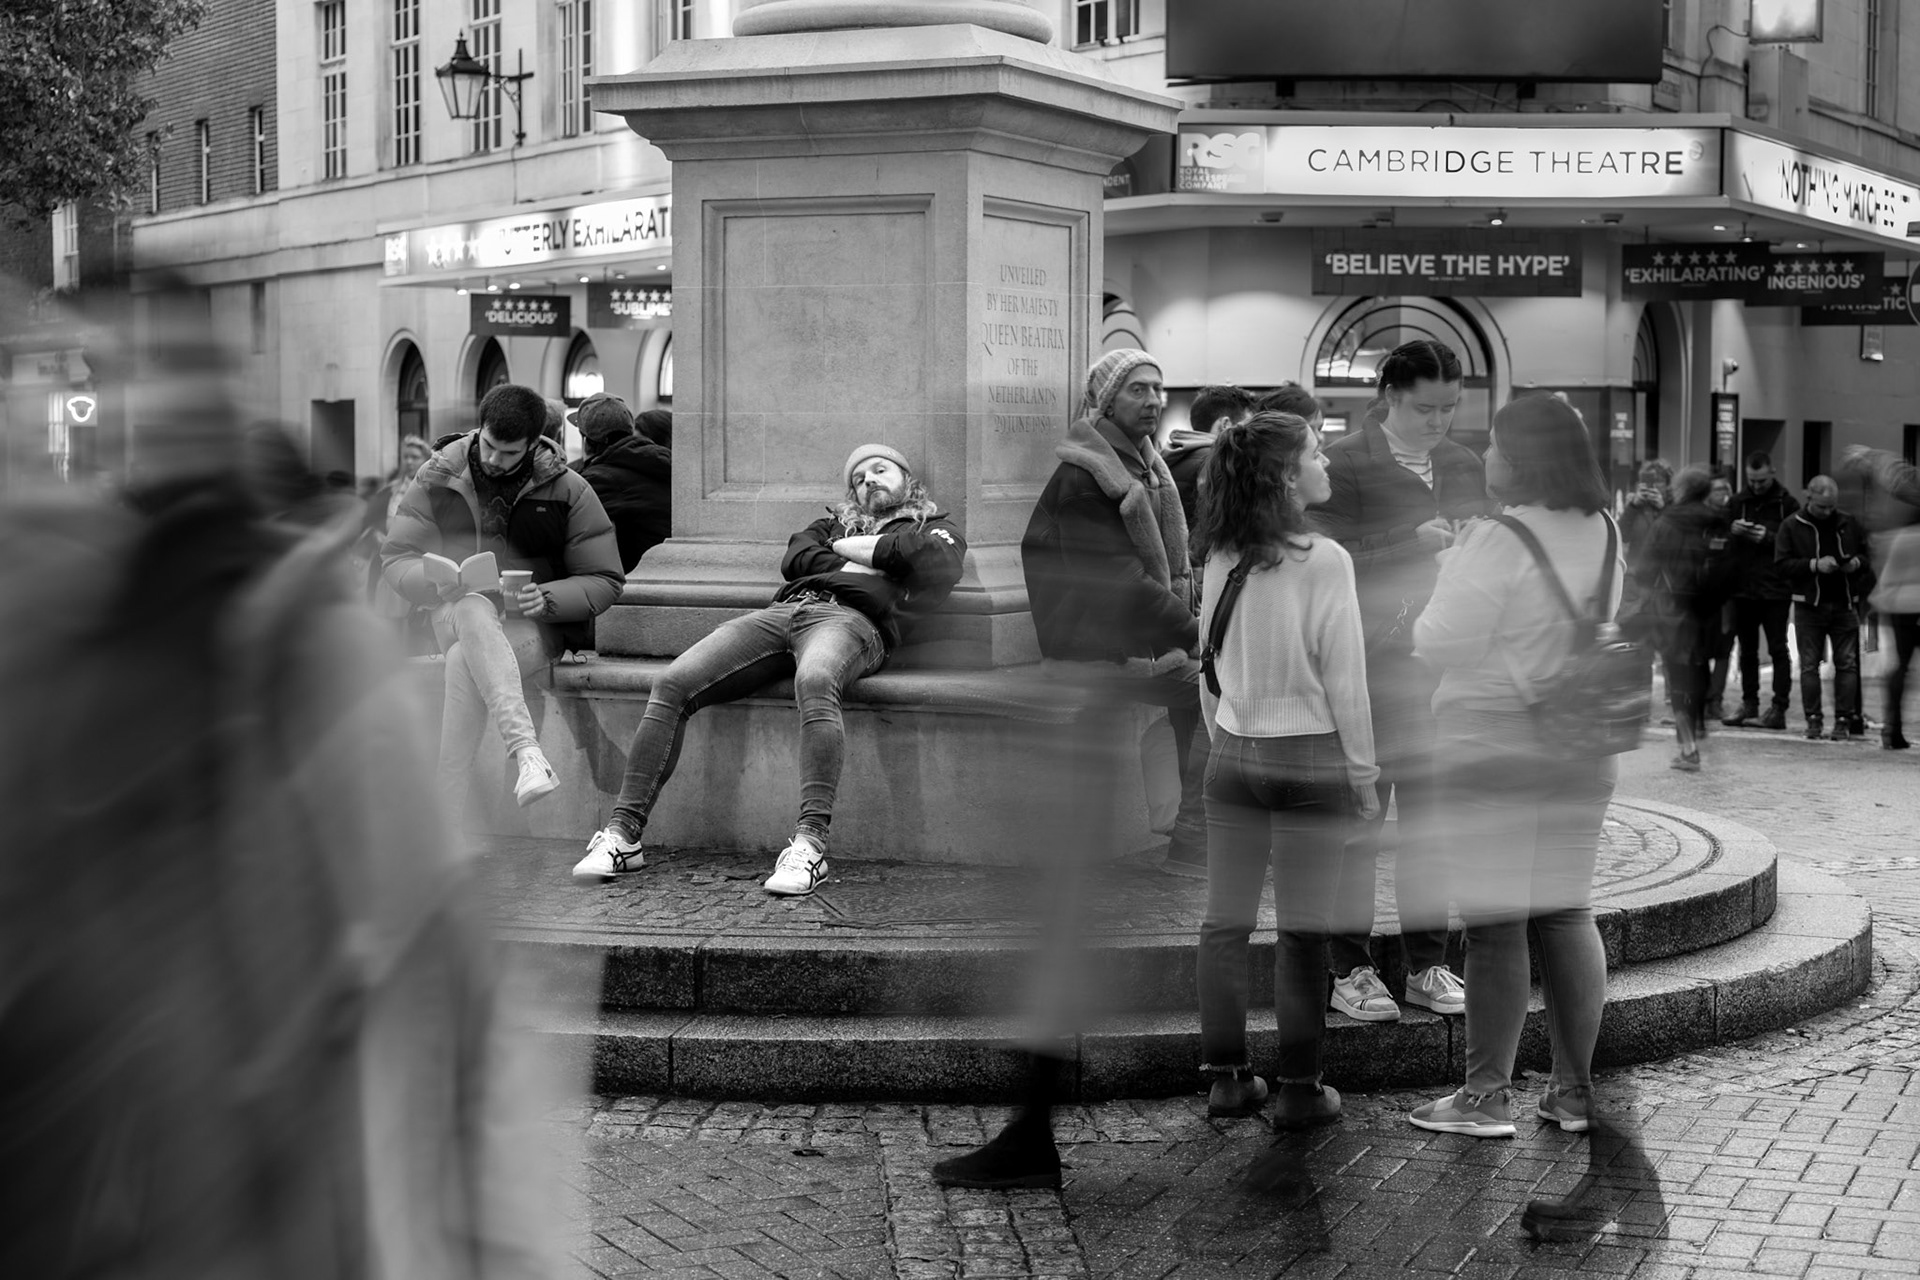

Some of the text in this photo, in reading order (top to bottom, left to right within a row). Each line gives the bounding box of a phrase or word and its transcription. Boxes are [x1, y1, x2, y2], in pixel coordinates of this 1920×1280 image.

[1308, 149, 1684, 175] CAMBRIDGE THEATRE
[1000, 264, 1047, 286] UNVEILED
[1325, 254, 1570, 276] ‘BELIEVE THE HYPE’
[1625, 265, 1765, 284] ‘EXHILARATING’
[987, 292, 1059, 317] BY HER MAJESTY
[981, 322, 1065, 357] QUEEN BEATRIX
[1007, 357, 1038, 376] OF THE
[986, 385, 1057, 405] NETHERLANDS
